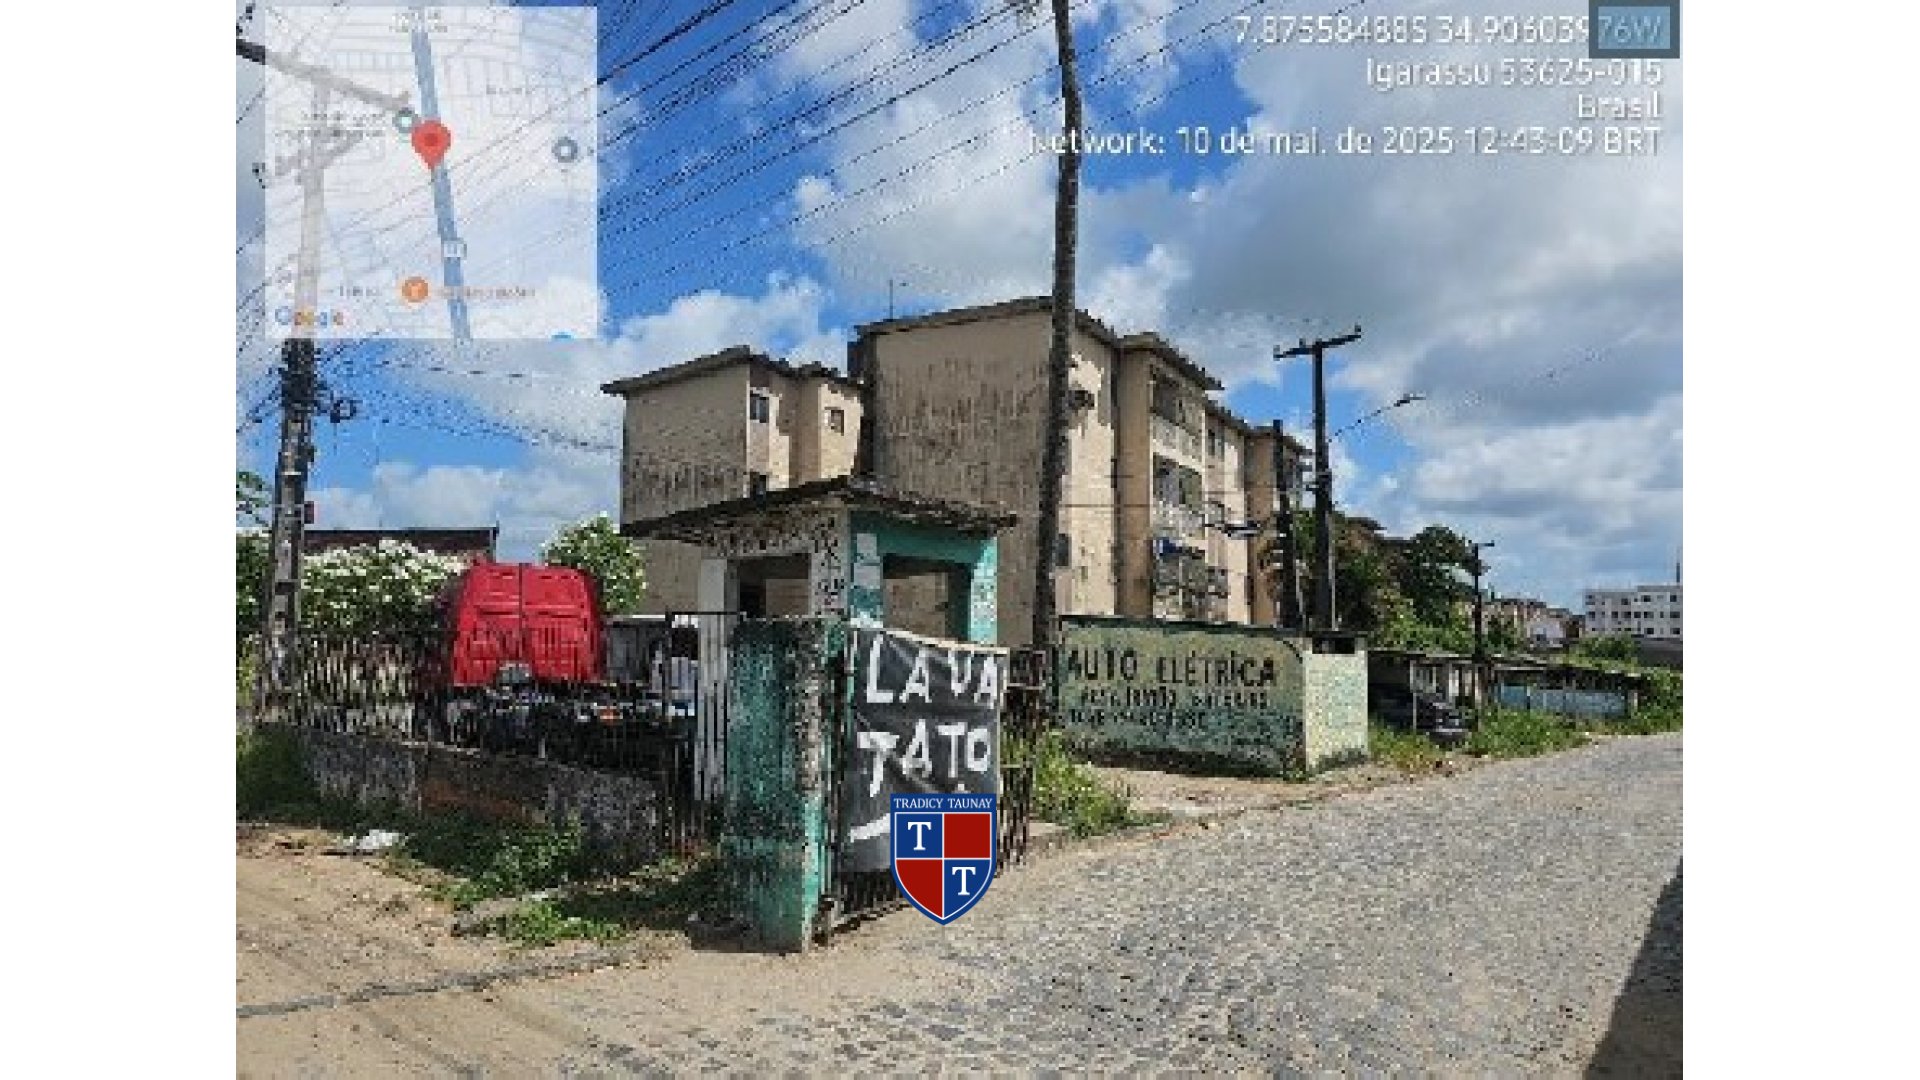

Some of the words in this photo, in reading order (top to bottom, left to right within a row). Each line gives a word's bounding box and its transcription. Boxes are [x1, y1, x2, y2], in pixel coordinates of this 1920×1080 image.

[866, 633, 999, 709] LAVA
[1067, 650, 1138, 681] AUTO
[856, 719, 992, 797] JATO
